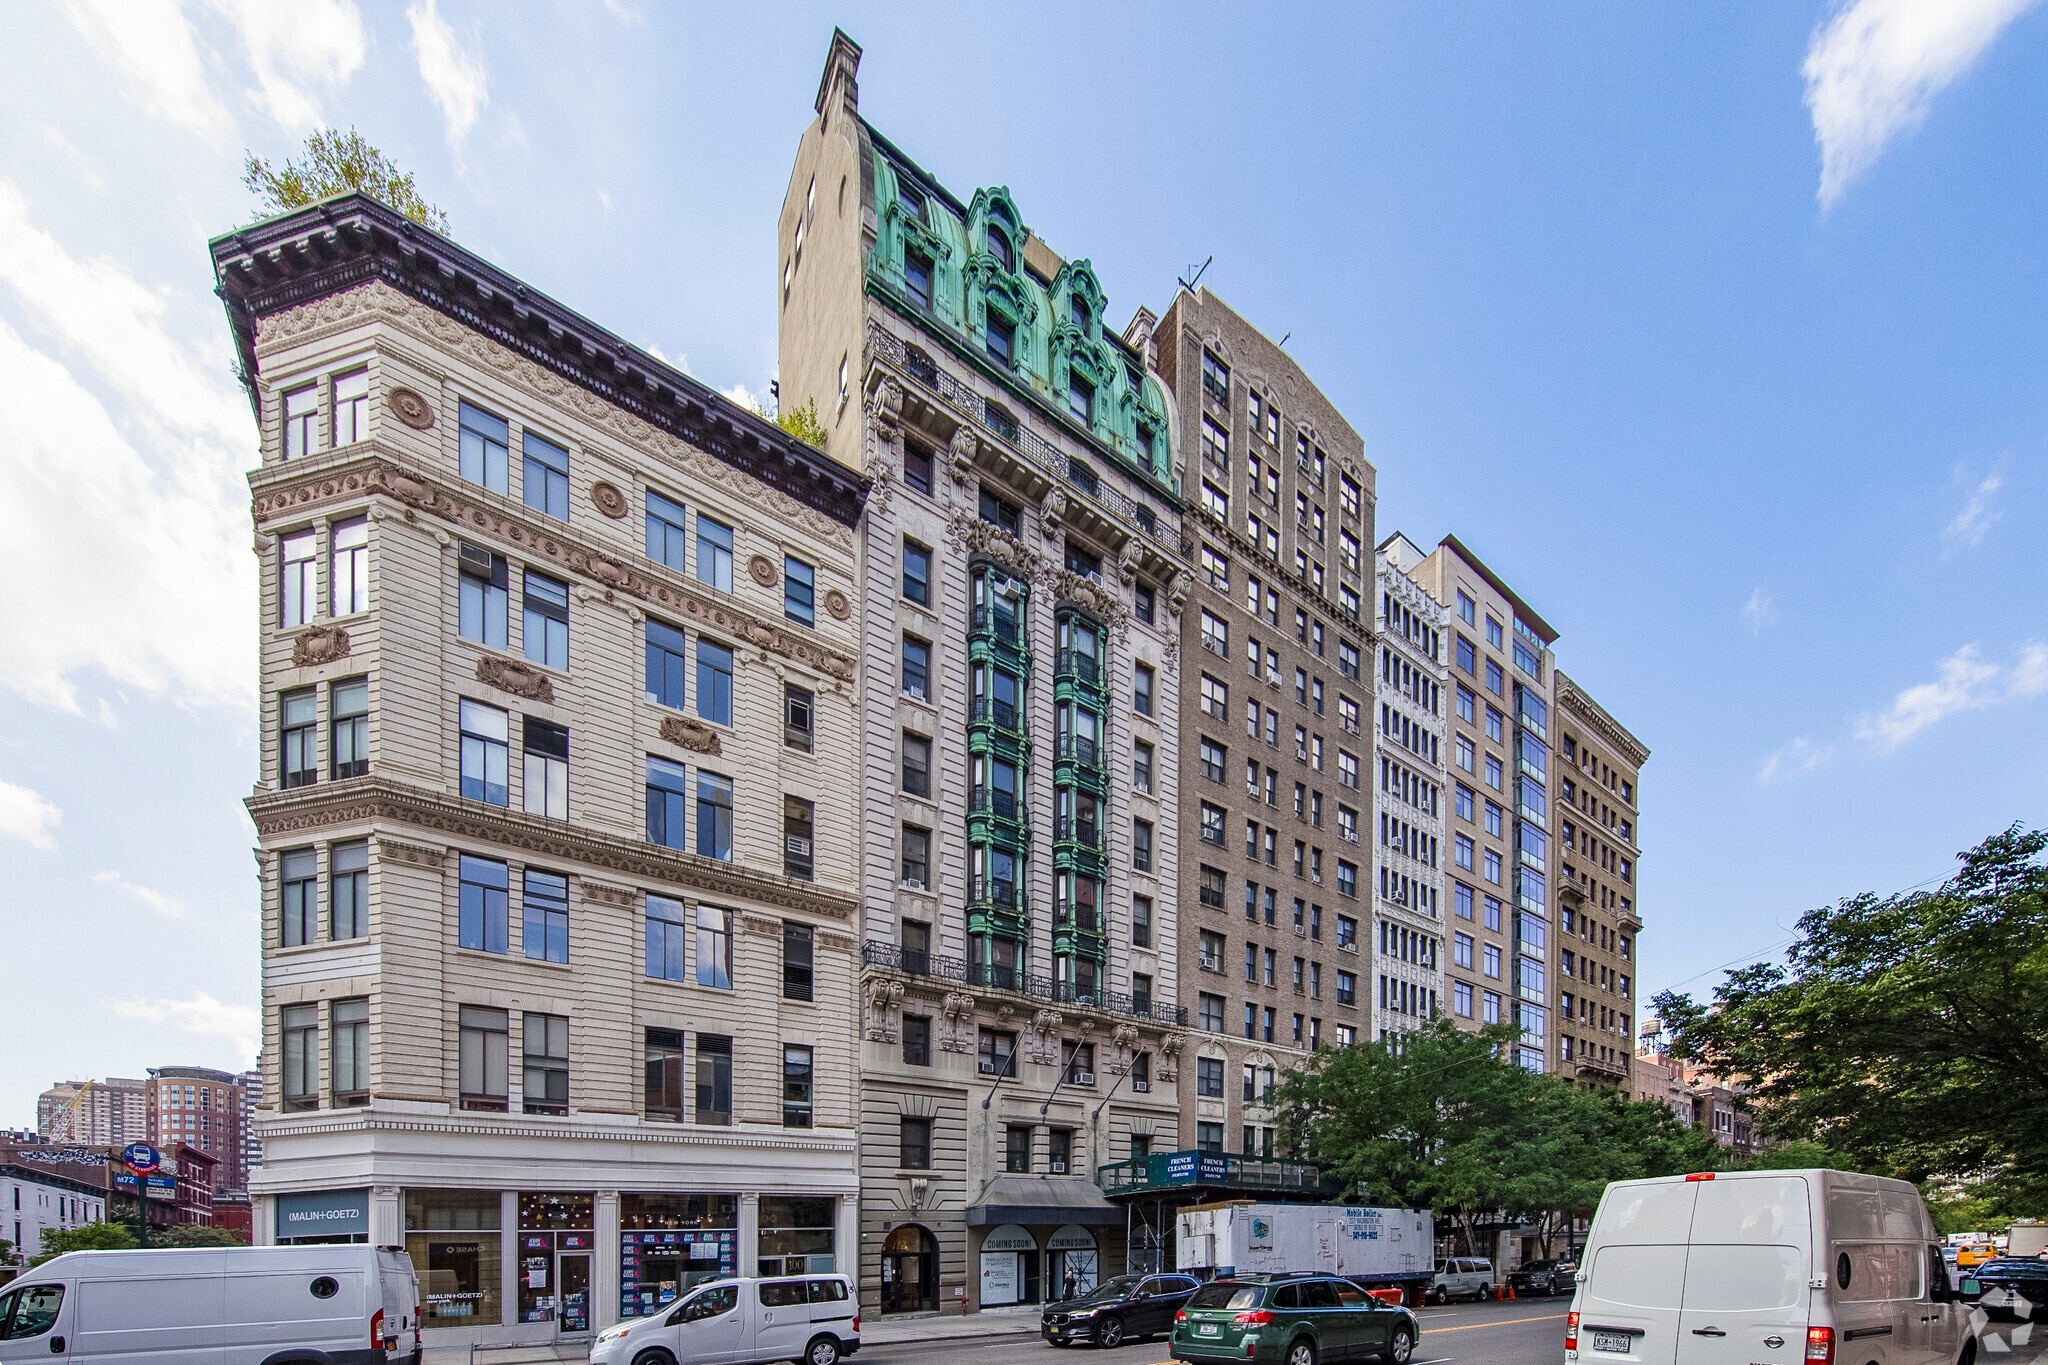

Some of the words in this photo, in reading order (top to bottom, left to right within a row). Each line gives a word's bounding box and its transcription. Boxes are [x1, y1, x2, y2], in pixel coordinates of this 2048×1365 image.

[1170, 1157, 1191, 1165] FRENCH
[1167, 1164, 1194, 1172] CLEANERS
[288, 1209, 359, 1221] (MALIN+GOETZ)
[987, 1240, 1012, 1249] COMING
[1013, 1240, 1031, 1248] SOON!
[788, 1260, 803, 1270] 100
